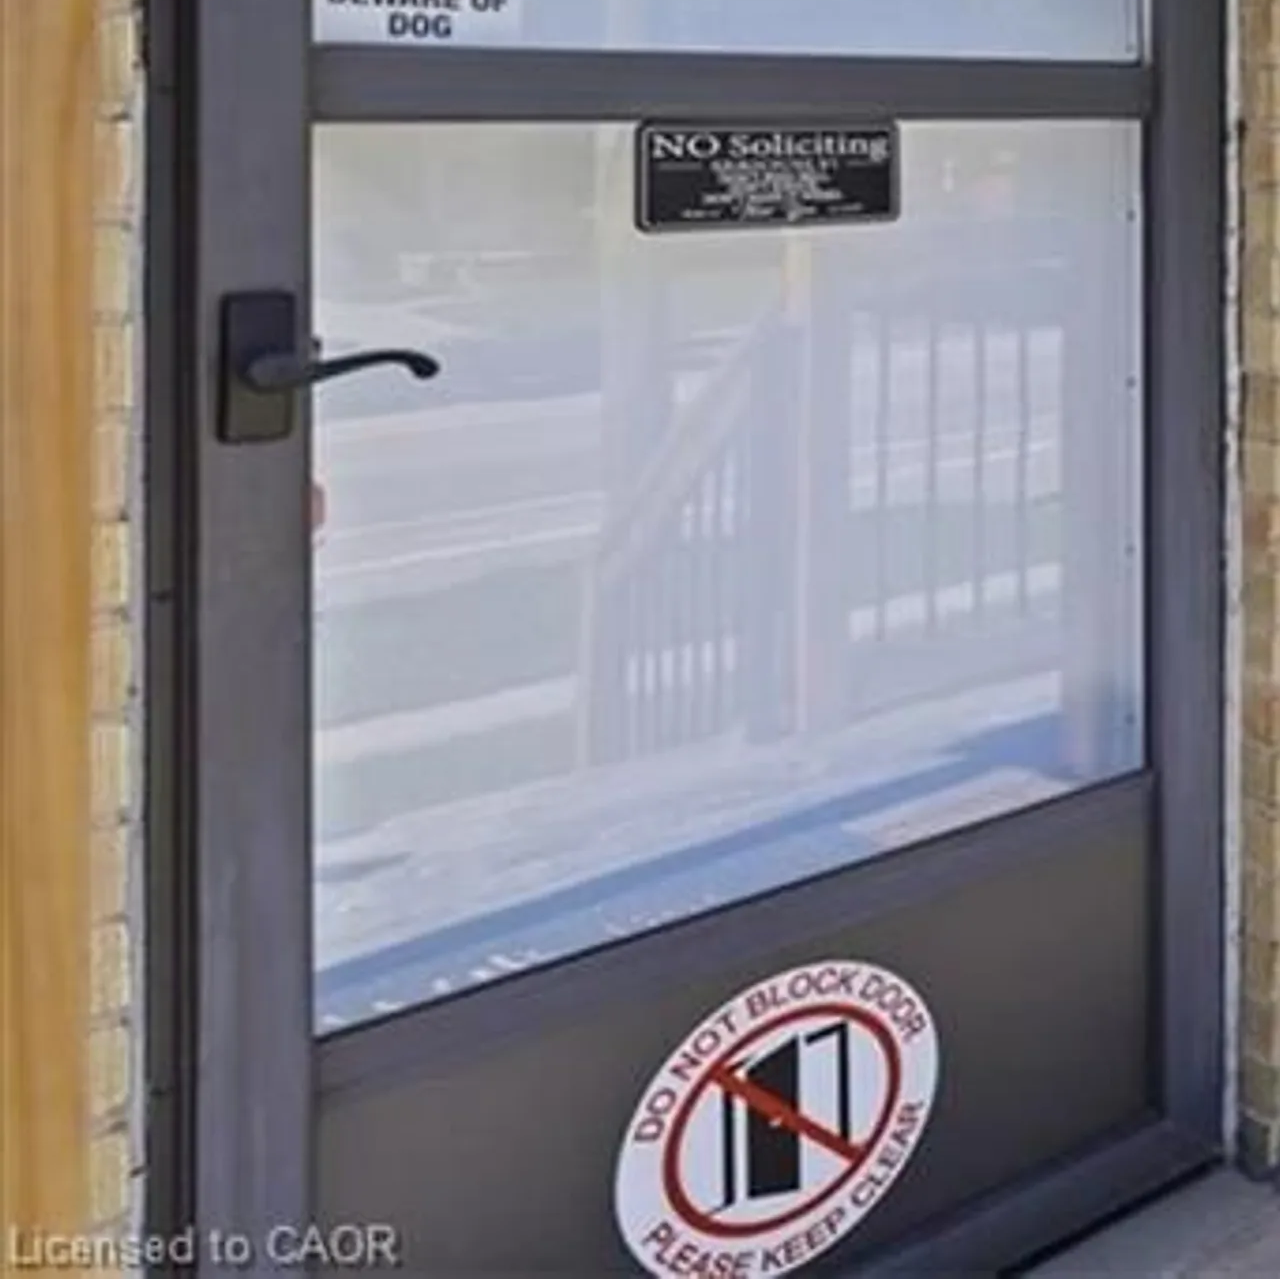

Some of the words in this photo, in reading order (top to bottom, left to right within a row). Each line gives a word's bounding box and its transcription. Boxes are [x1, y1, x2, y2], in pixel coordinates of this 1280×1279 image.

[388, 14, 452, 38] DOG
[653, 133, 721, 159] NO
[727, 133, 888, 162] Soliciting
[634, 1088, 677, 1143] DO
[670, 1012, 739, 1080] NOT
[745, 968, 855, 1018] BLOCK
[858, 974, 926, 1043] DOOR
[640, 1222, 756, 1279] PLEASE
[761, 1207, 846, 1271] KEEP
[850, 1100, 924, 1209] CLEAR
